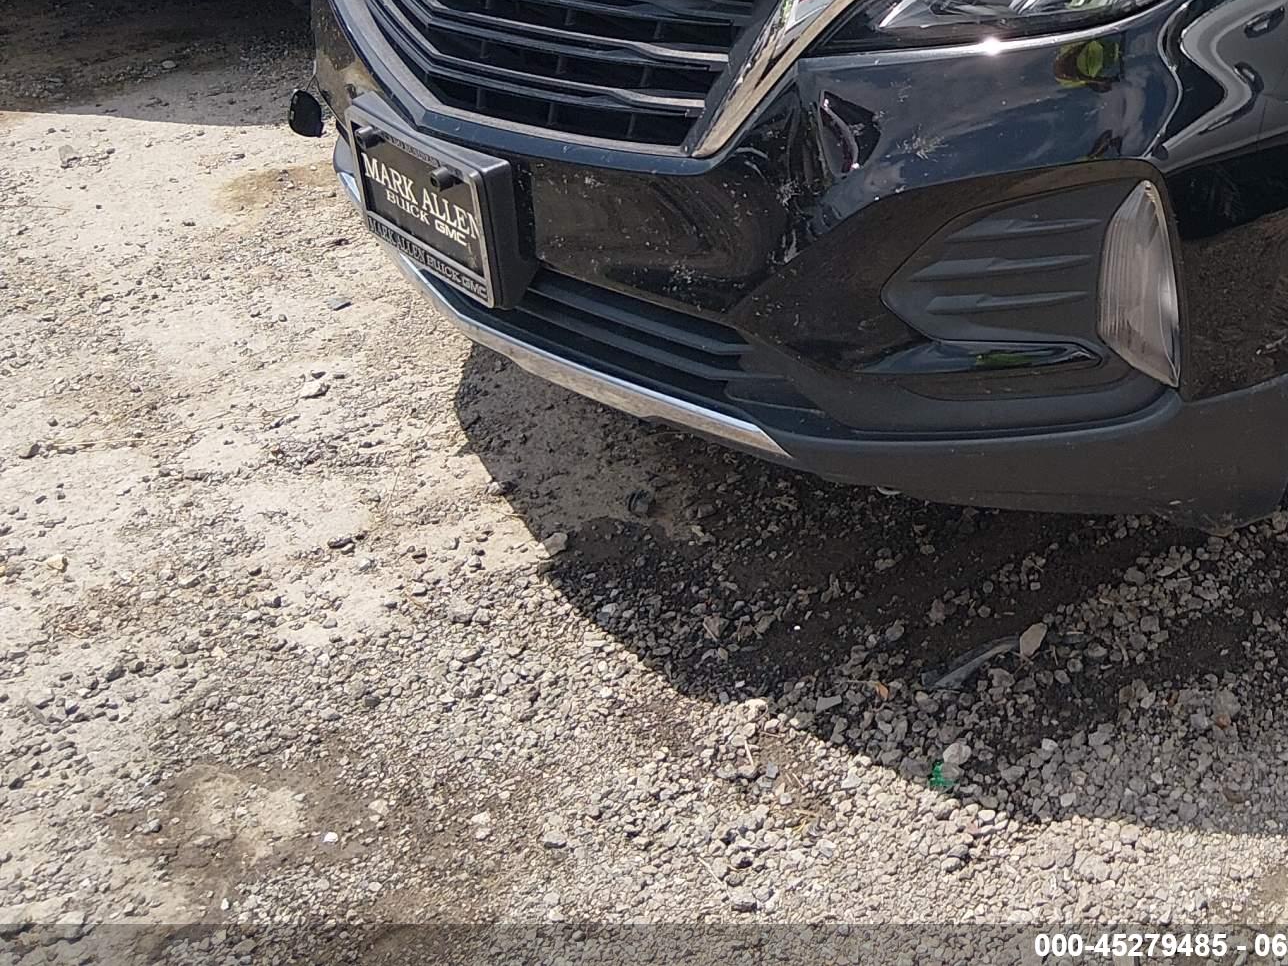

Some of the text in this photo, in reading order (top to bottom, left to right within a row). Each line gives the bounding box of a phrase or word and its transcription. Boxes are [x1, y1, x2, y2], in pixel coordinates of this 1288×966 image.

[361, 152, 481, 240] MARK ALLEN
[386, 189, 468, 246] BUICK GMC
[368, 217, 488, 297] MARK ALLEN BUICK GMC
